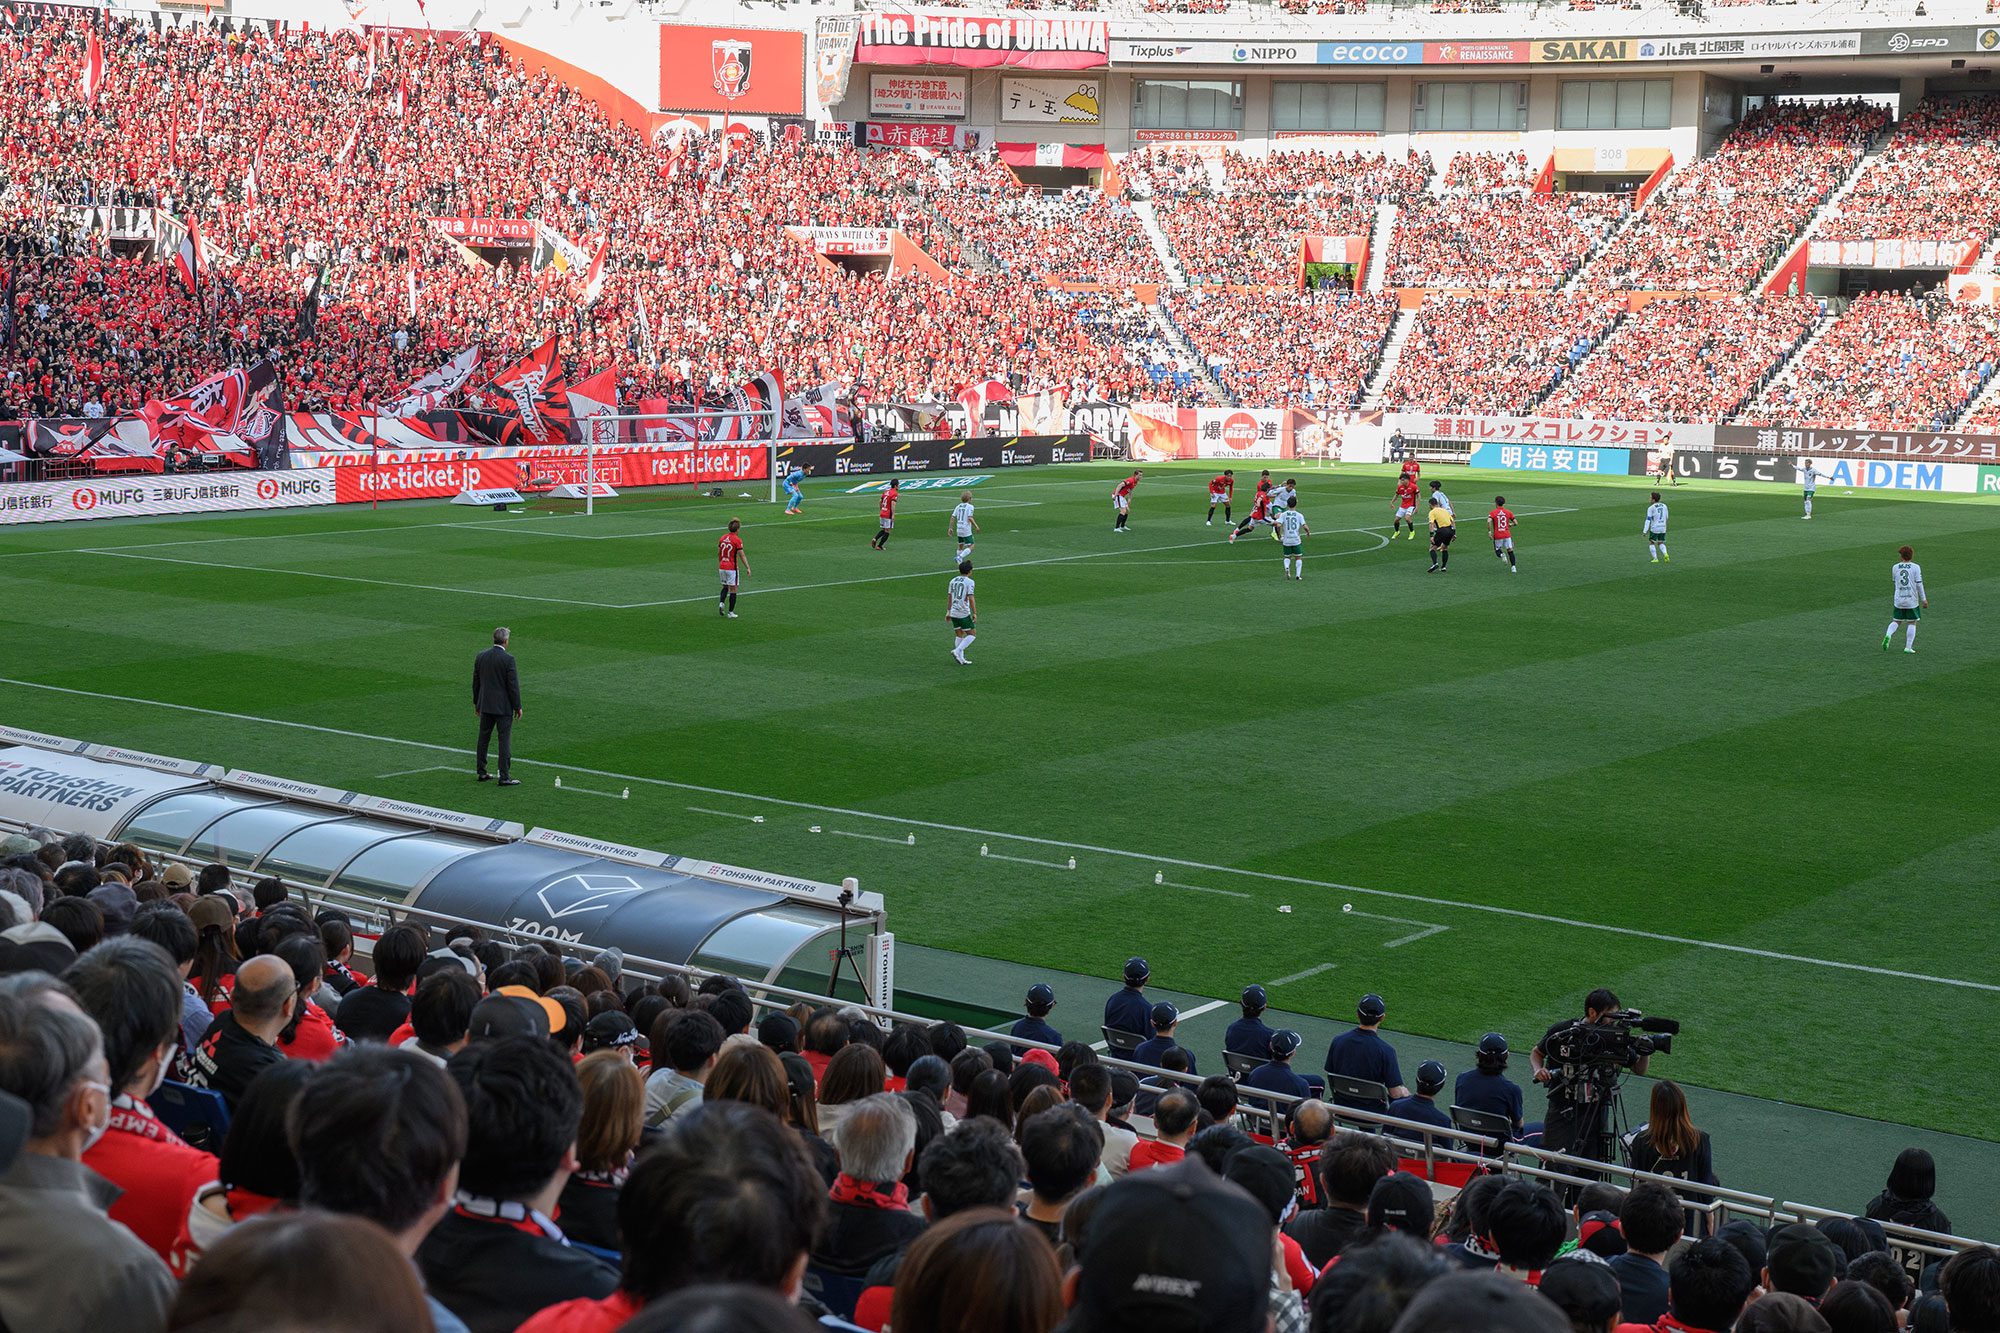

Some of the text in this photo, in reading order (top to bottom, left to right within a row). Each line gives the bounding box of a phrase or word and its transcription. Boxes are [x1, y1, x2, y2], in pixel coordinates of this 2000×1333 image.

[15, 2, 95, 20] FLAMES
[820, 20, 851, 33] PRIDE
[861, 13, 1106, 53] The Pride of URAWA
[818, 38, 850, 51] URAWA
[1542, 41, 1626, 61] SAKAI
[1750, 38, 1856, 51] ロイヤルパインズホテル浦和
[1911, 38, 1950, 48] SPD
[1128, 45, 1174, 59] Tixplus
[1251, 47, 1297, 60] NIPPO
[1332, 43, 1408, 61] ecoco
[1460, 50, 1514, 60] RENAISSANCE
[889, 79, 948, 90] 伸ばそう地下鉄
[1010, 92, 1057, 115] テレ玉
[818, 131, 833, 139] TO
[822, 122, 848, 131] REDS
[887, 125, 950, 145] 赤酔連
[1039, 144, 1060, 155] 307
[1600, 149, 1623, 160] 308
[842, 230, 862, 240] WITH
[864, 230, 874, 240] US
[1323, 238, 1346, 250] 213
[1203, 420, 1221, 441] 爆
[1259, 420, 1277, 441] 進
[1434, 418, 1673, 444] 浦和レッズコレクション
[893, 455, 908, 470] EY
[948, 452, 963, 467] EY
[1001, 449, 1016, 464] EY
[1052, 447, 1065, 461] EY
[1501, 446, 1599, 472] 明治安田
[652, 450, 751, 478] rex-ticket.jp
[776, 460, 791, 477] EY
[836, 458, 851, 473] EY
[359, 462, 480, 491] rex-ticket.jp
[1828, 460, 1943, 491] AiDEM
[100, 484, 240, 505] MUFG 三菱UFJ信託銀行
[281, 479, 321, 495] MUFG
[487, 491, 517, 499] WINNER
[1497, 515, 1507, 528] 13
[1657, 507, 1664, 520] 7
[1286, 517, 1298, 531] 16
[1900, 569, 1910, 586] 3
[951, 582, 965, 600] 40
[2, 730, 62, 747] TOHSHIN PARTNERS
[114, 751, 180, 769] TOHSHIN PARTNERS
[16, 766, 145, 799] TOHSHIN
[246, 775, 318, 796] TOHSHIN PARTNERS
[3, 776, 120, 813] PARTNERS
[386, 802, 466, 824] TOHSHIN PARTNERS
[550, 833, 639, 859] TOHSHIN PARTNERS
[718, 867, 817, 895] TOHSHIN PARTNERS
[1133, 1273, 1201, 1299] AVIREX
